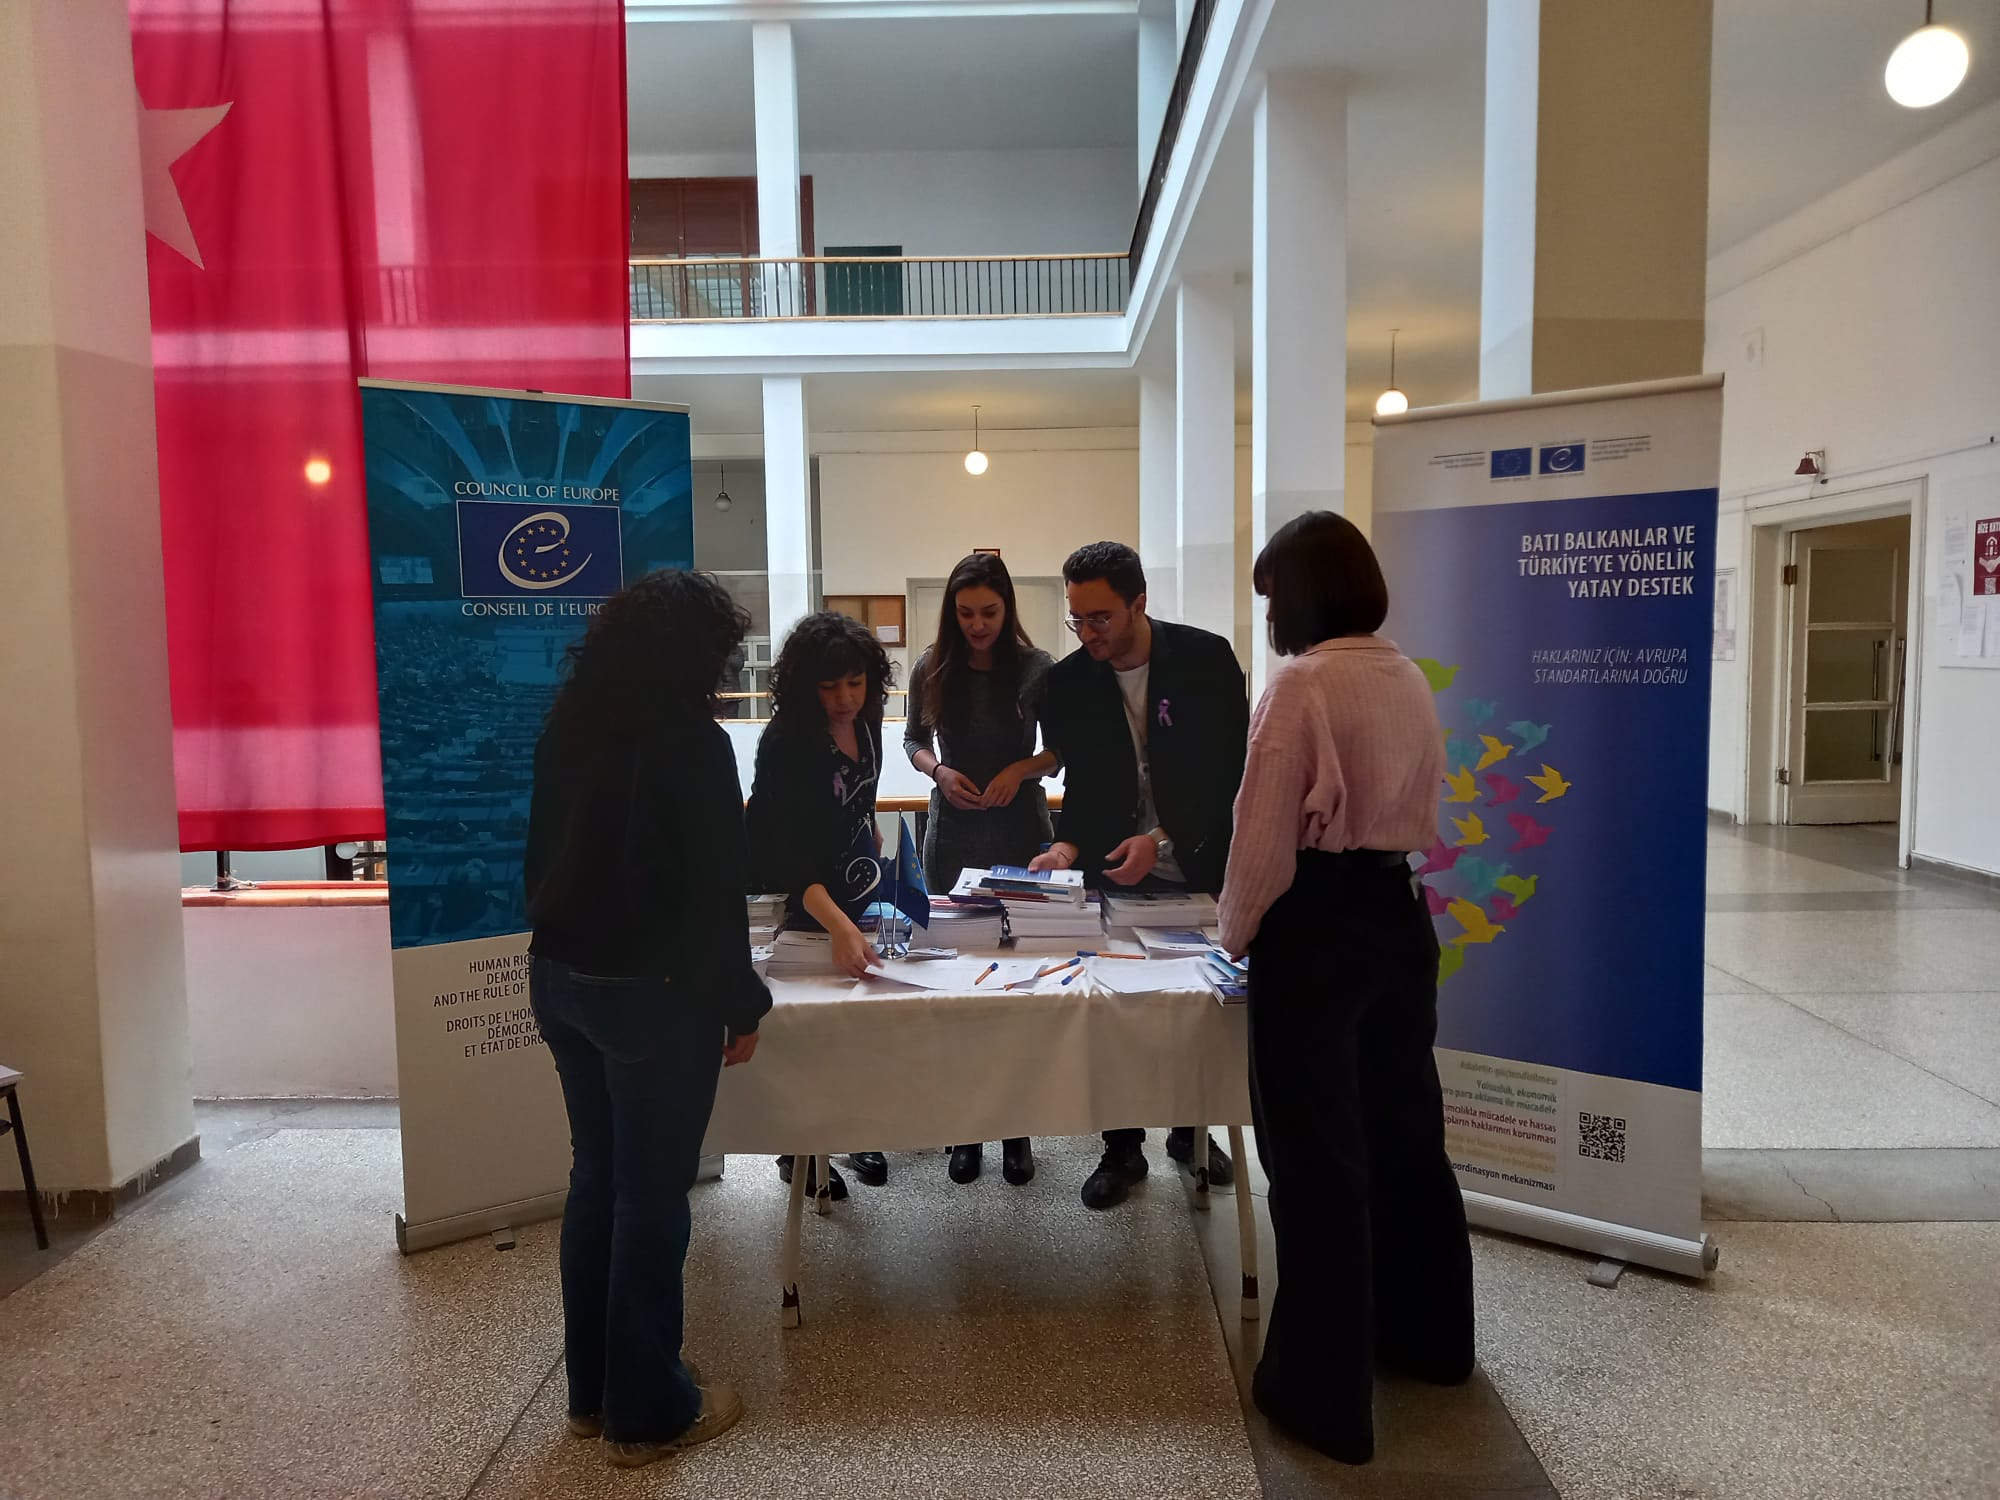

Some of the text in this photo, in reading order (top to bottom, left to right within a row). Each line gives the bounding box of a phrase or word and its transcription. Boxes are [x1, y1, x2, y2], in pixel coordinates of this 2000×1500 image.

[454, 482, 620, 500] COUNCIL OF EUROPE
[1522, 525, 1695, 552] BATI BALKANLAR VE
[1518, 548, 1695, 576] TÜRKİYE'YE YÖNELİK
[1568, 576, 1694, 598] YATAY DESTEK
[462, 603, 530, 616] CONSEIL
[535, 604, 554, 616] DE
[1532, 648, 1602, 664] HAKLARINIZ
[1636, 648, 1687, 664] AVRUPA
[1534, 666, 1688, 684] STANDARTLARINA DOĞRU
[470, 956, 510, 973] HUMAN
[434, 982, 526, 1007] AND THE RULE OF
[446, 1015, 485, 1033] DROITS
[488, 1012, 502, 1026] DE
[465, 1045, 476, 1058] ET
[481, 1038, 505, 1055] ÉTAT
[508, 1036, 520, 1050] DE
[1516, 1089, 1557, 1103] ekonomik
[1472, 1120, 1512, 1136] haklarının
[1512, 1128, 1557, 1144] korunması
[1480, 1110, 1516, 1126] mücadele
[1518, 1118, 1528, 1127] ve
[1530, 1120, 1557, 1133] hassas
[1452, 1161, 1556, 1192] oordinasyon mekanizması
